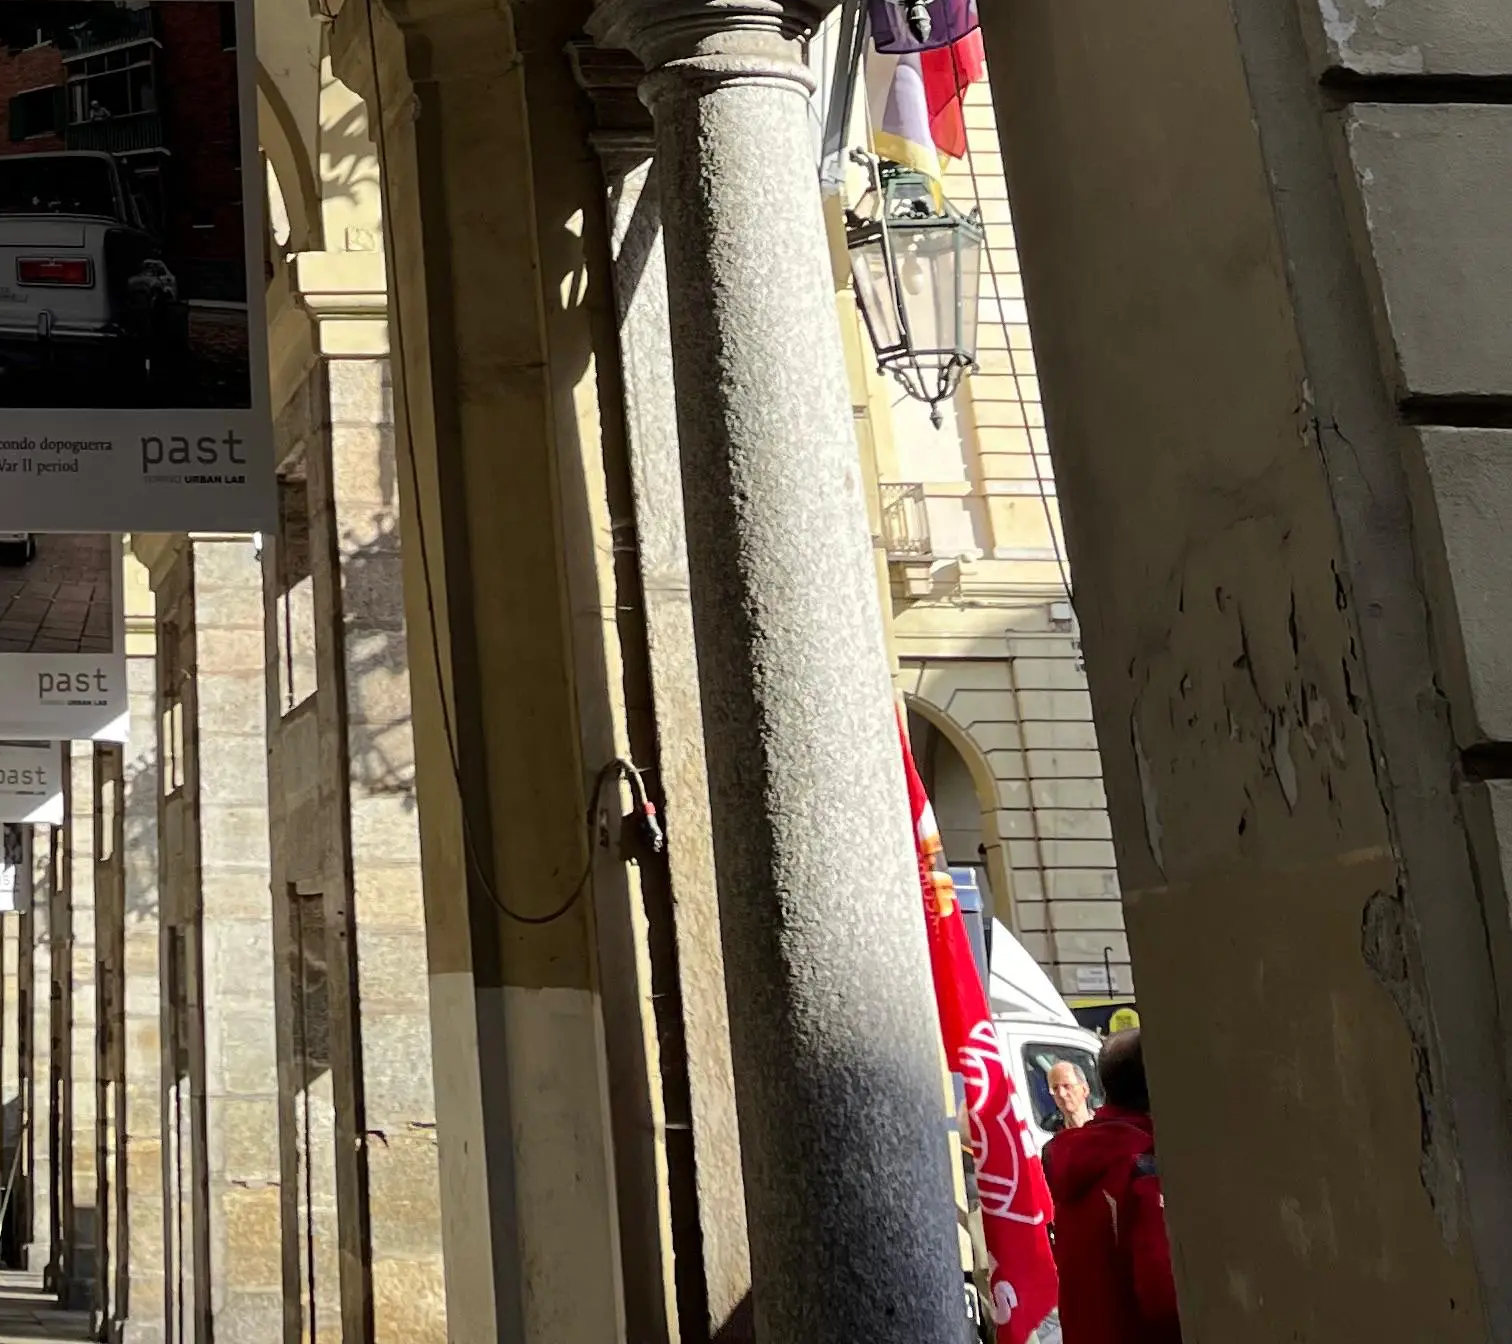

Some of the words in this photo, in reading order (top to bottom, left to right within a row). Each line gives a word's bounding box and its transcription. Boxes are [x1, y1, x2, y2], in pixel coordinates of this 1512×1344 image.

[39, 436, 113, 454] dopoguerra
[140, 428, 247, 474] past
[37, 458, 79, 476] period
[184, 475, 222, 484] URBAN
[38, 668, 108, 699] past
